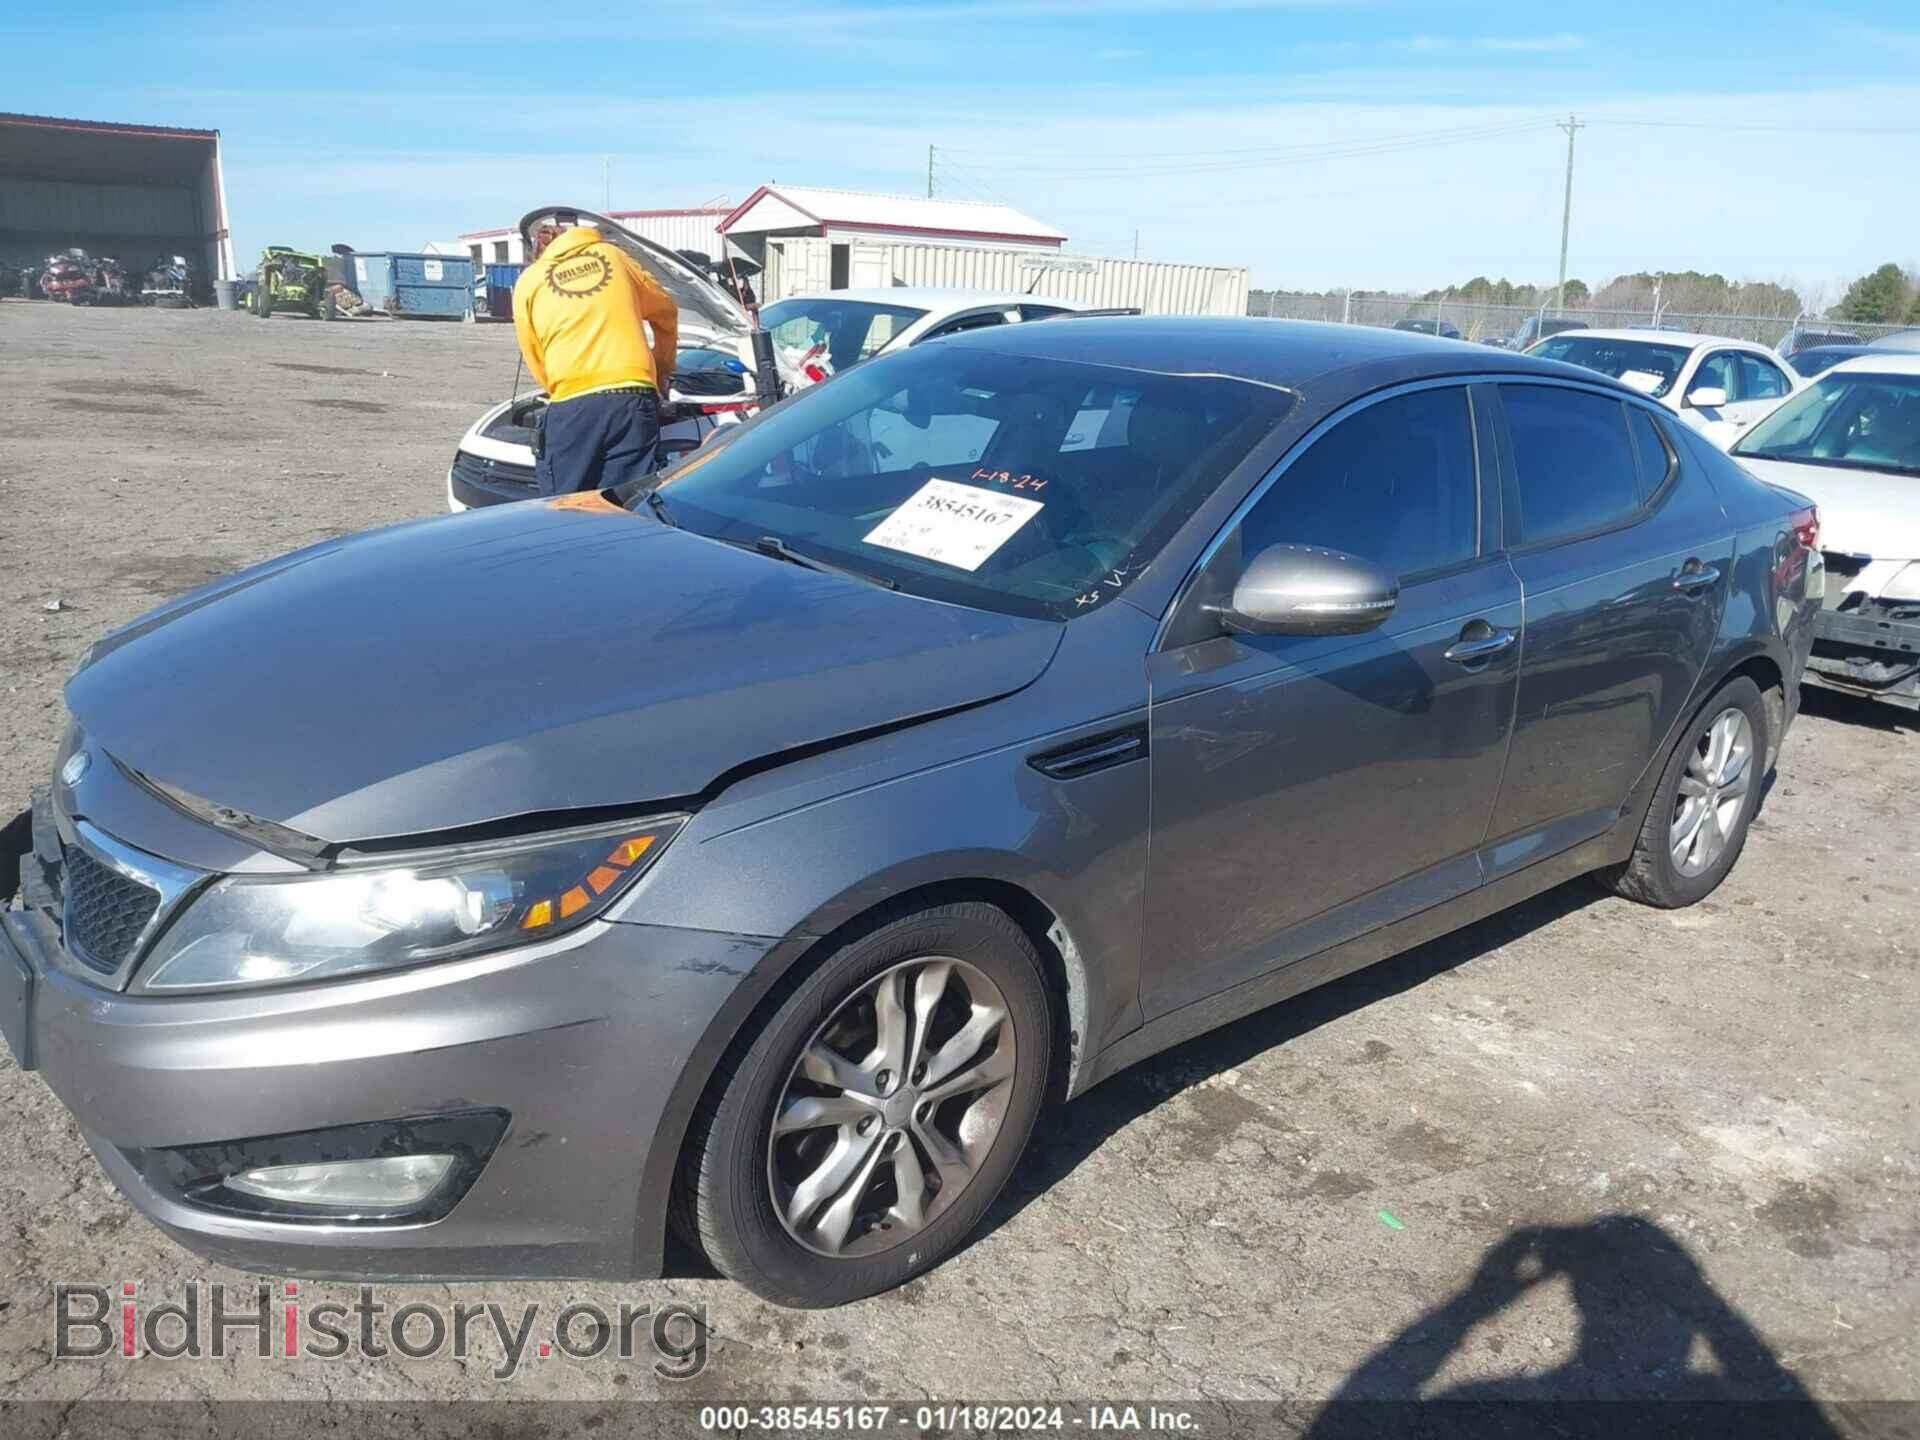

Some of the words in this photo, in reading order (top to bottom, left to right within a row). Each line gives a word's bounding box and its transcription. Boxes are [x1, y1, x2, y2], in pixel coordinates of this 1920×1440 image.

[555, 260, 600, 281] WILSON
[971, 468, 1048, 491] 1-18-24
[917, 495, 1014, 526] 38545167
